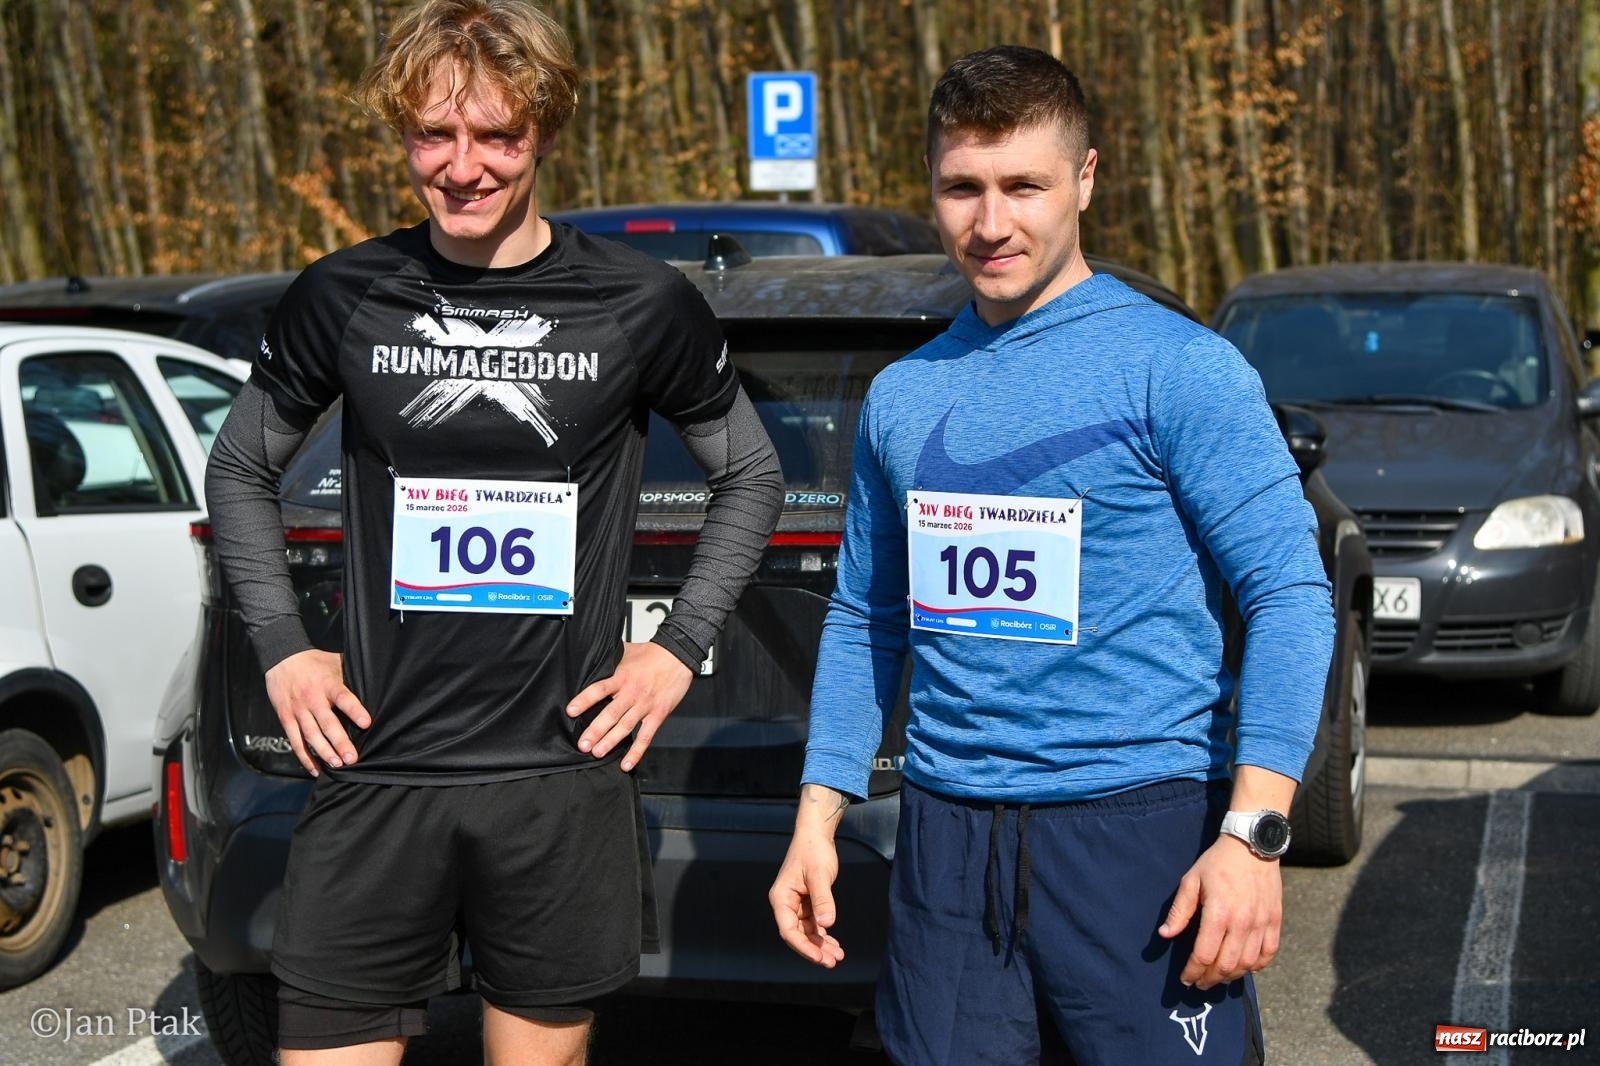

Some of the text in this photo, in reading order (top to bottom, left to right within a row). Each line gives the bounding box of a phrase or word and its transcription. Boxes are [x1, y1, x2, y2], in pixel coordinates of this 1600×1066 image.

[763, 80, 803, 136] P
[441, 305, 529, 319] SMMASH
[372, 345, 599, 382] RUNMAGEDDON
[406, 488, 563, 504] XIV BIEG TWARDZIELA
[798, 493, 840, 504] ZERO
[406, 503, 414, 511] 15
[446, 504, 468, 512] 2026
[919, 503, 1067, 524] XIV BIEG TWARDZIELA
[918, 520, 973, 531] 15 marzec 2026
[431, 526, 536, 576] 106
[940, 545, 1037, 601] 105
[497, 593, 531, 601] Racibórz
[1000, 619, 1033, 630] Racibórz
